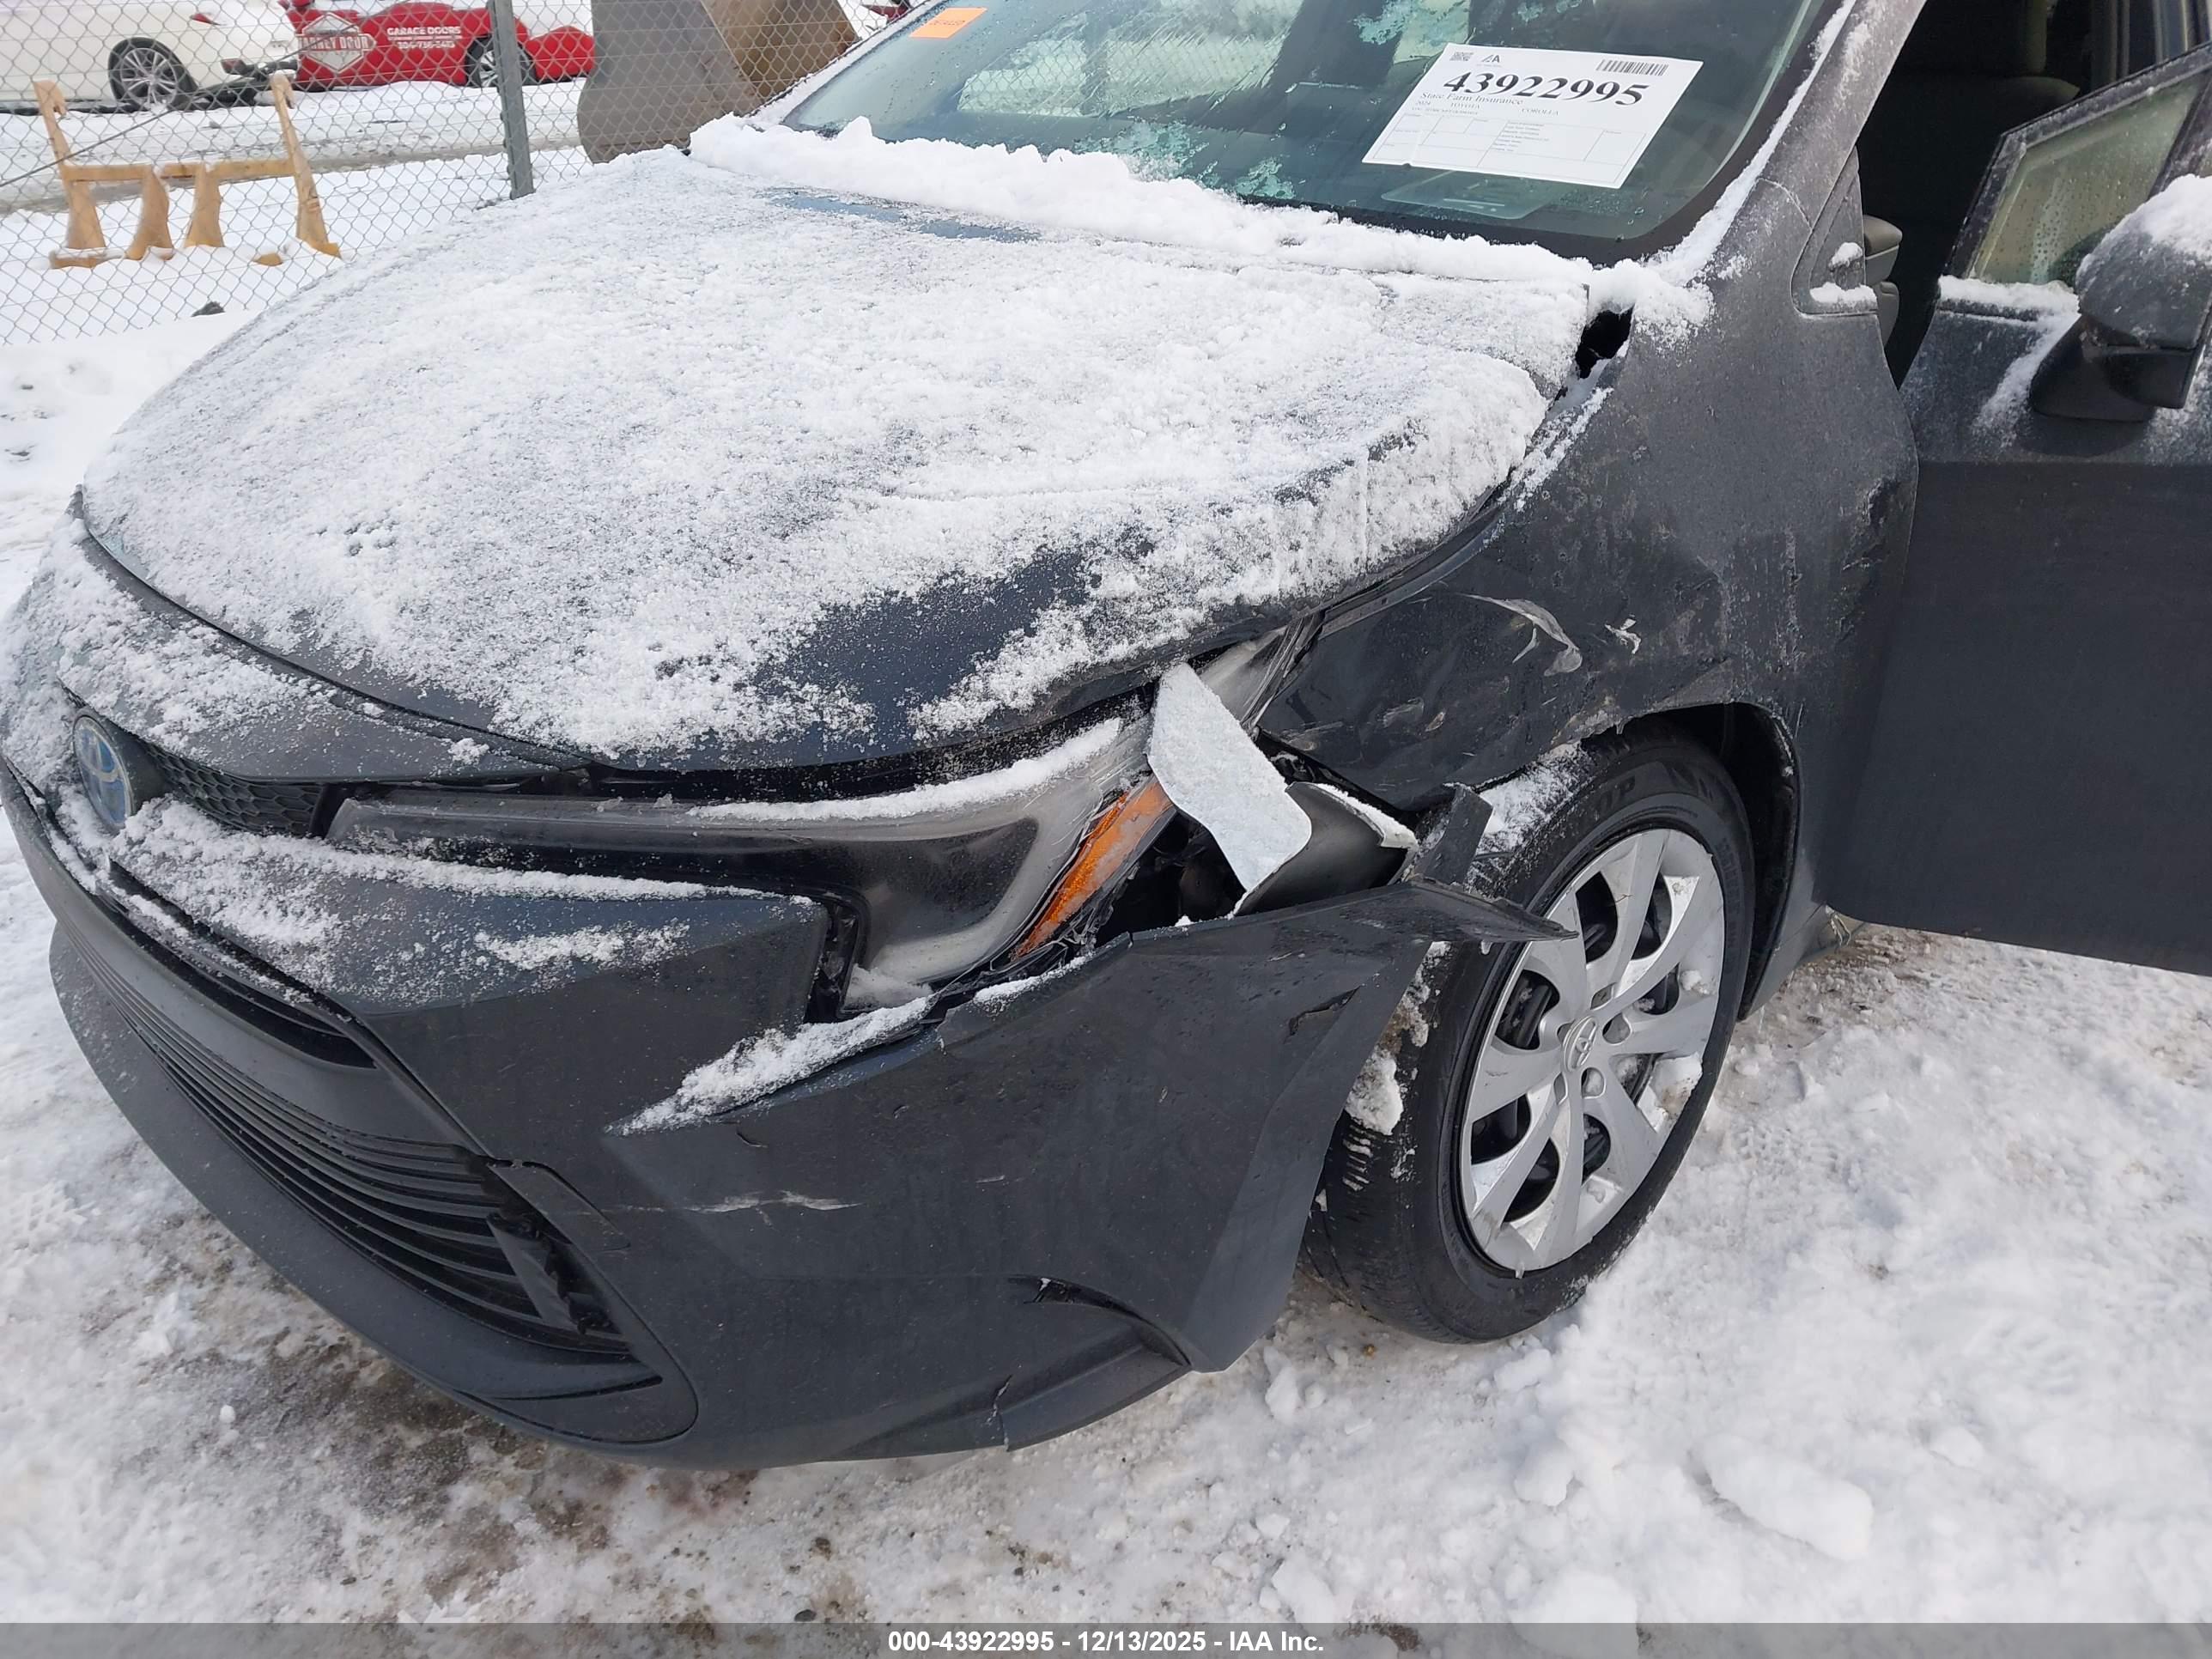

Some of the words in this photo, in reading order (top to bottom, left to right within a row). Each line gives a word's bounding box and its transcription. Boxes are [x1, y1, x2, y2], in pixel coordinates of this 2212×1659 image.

[387, 27, 426, 35] GARAGE
[427, 26, 461, 34] DOORS
[1443, 71, 1650, 106] 43922995
[1421, 92, 1444, 100] State
[1446, 93, 1473, 102] Farm
[1475, 95, 1523, 105] Insurance
